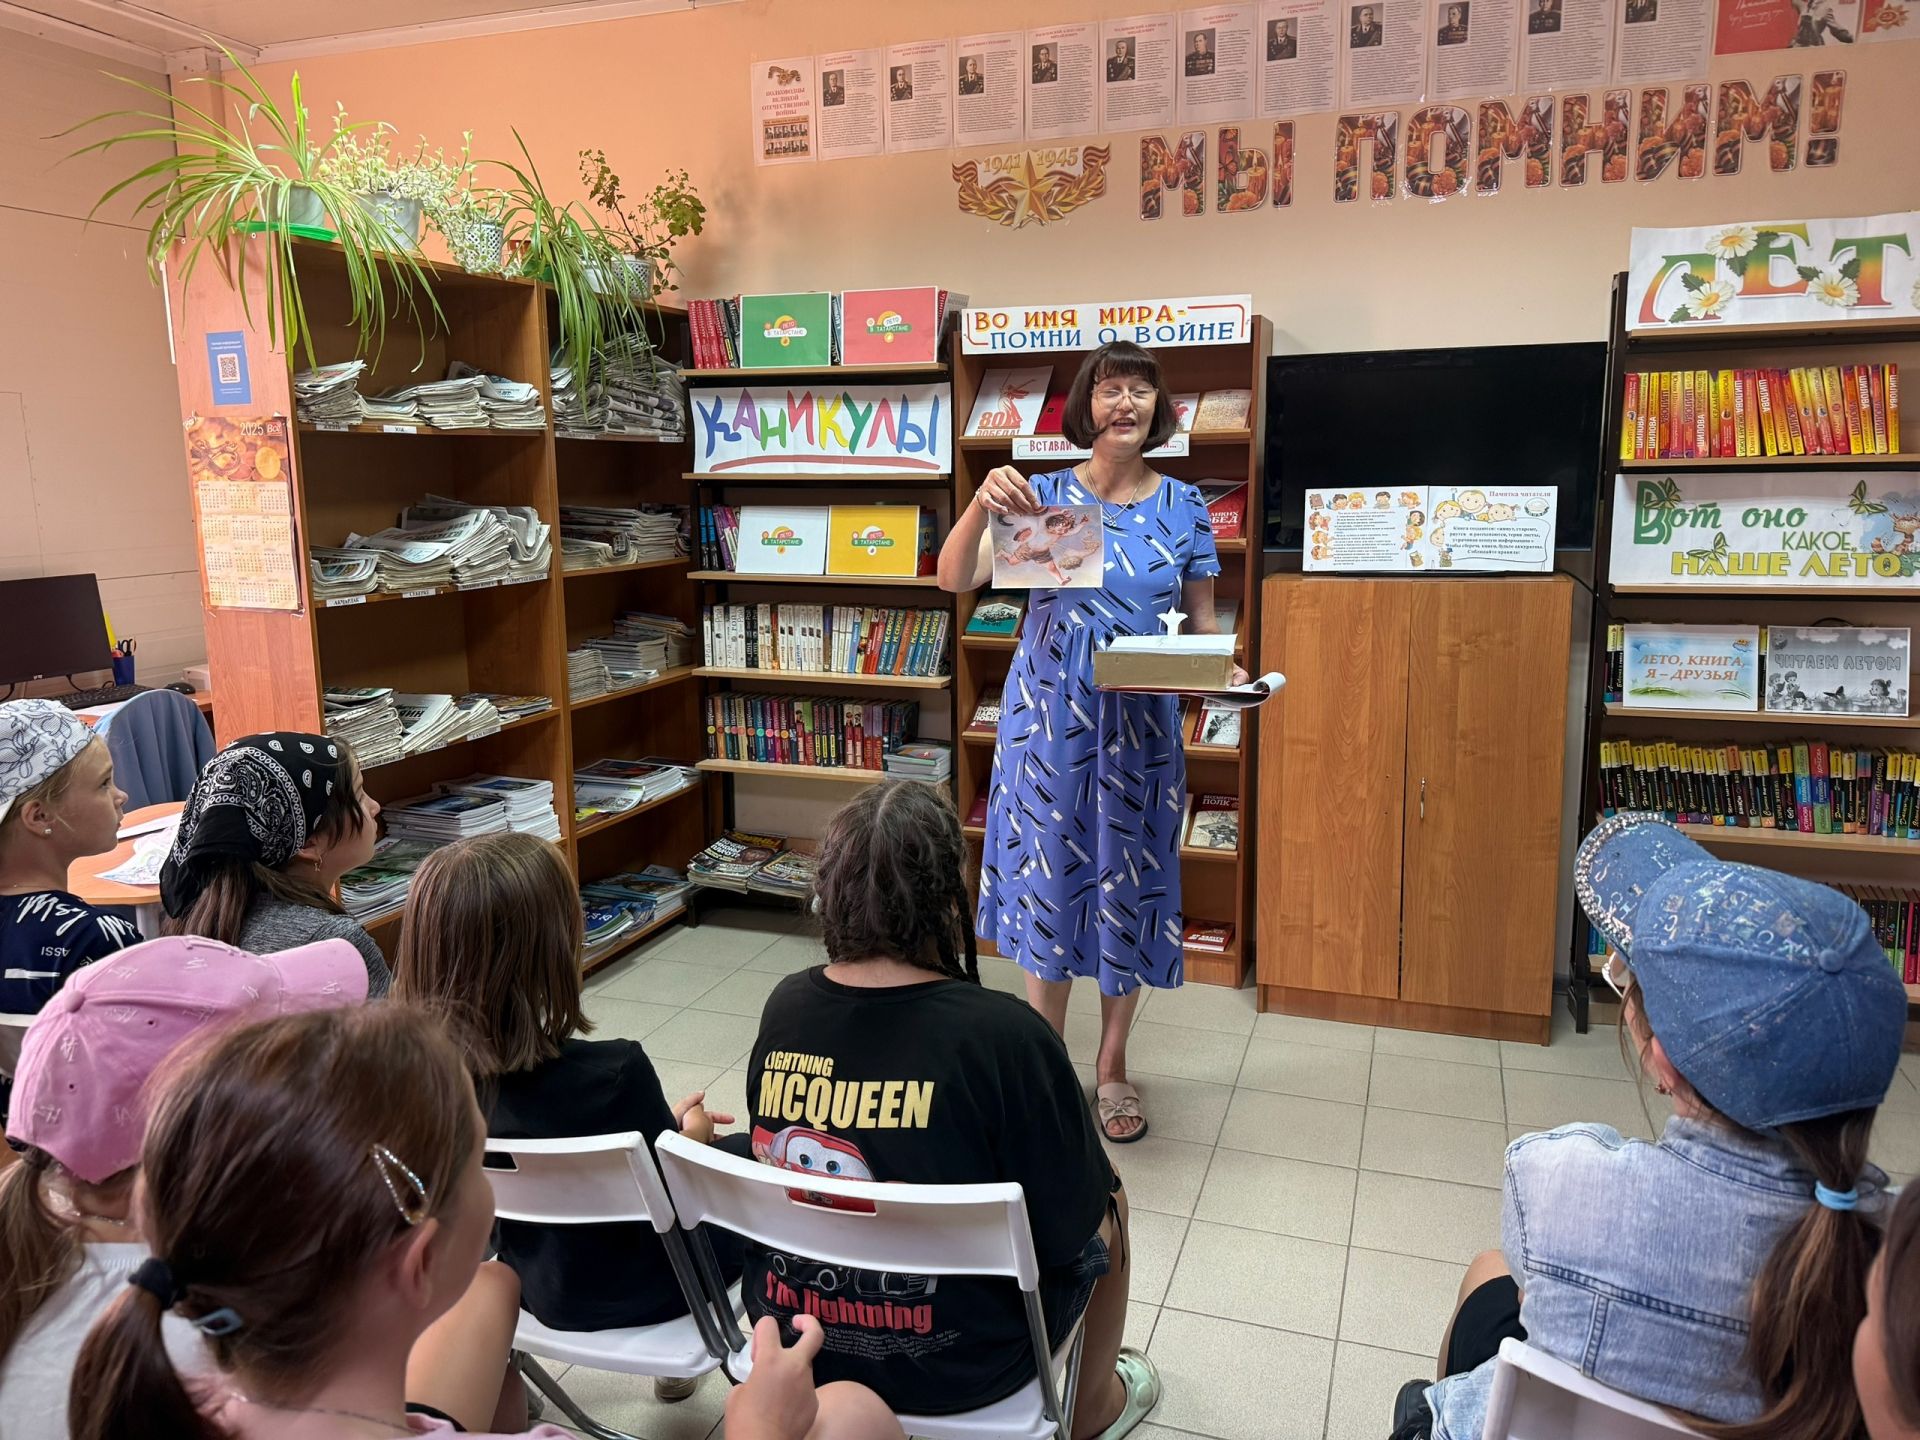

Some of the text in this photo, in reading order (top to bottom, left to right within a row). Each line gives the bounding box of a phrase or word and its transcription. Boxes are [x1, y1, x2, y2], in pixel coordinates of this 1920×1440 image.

[1036, 147, 1079, 169] 1945
[1139, 70, 1847, 221] МЫ ПОМНИМ!
[983, 153, 1021, 175] 1941
[876, 325, 909, 333] ТАТАРСТАНЕ
[885, 316, 900, 326] ЛЕТО
[975, 311, 1009, 332] ВО
[1024, 309, 1078, 328] ИМЯ
[990, 321, 1235, 350] ПОМНИ О ВОЙНЕ
[1684, 388, 1693, 423] ШИЛОВА
[1734, 380, 1743, 413] ШИЛОВА
[1758, 379, 1770, 413] ШИЛОВА
[1859, 375, 1870, 410] ШИЛОВА
[1889, 374, 1898, 409] ШИЛОВА
[979, 411, 1006, 428] 80
[1661, 390, 1669, 424] ШИЛОВА
[1849, 401, 1860, 436] ШИЛОВА
[240, 421, 264, 436] 2025
[695, 387, 939, 459] КАНИКУЛЫ
[1636, 416, 1644, 449] ШИЛОВА
[1648, 416, 1656, 449] ШИЛОВА
[1697, 414, 1705, 448] ШИЛОВА
[1633, 478, 1809, 545] Вот оно
[1670, 551, 1903, 577] НАШЕ ЛЕТО
[885, 613, 895, 636] СЕРОВА
[913, 613, 922, 636] СЕРОВА
[921, 613, 931, 636] СЕРОВА
[930, 613, 940, 637] СЕРОВА
[1638, 654, 1746, 668] ЛЕТО, КНИГА,
[1774, 653, 1902, 672] ЧИТАЕМ ЛЕТОМ
[1645, 669, 1658, 680] Я
[1671, 669, 1739, 682] ДРУЗЬЯ!
[764, 1051, 834, 1078] LIGHTNING
[758, 1071, 935, 1131] MCQUEEN
[765, 1270, 933, 1334] I'm lightning
